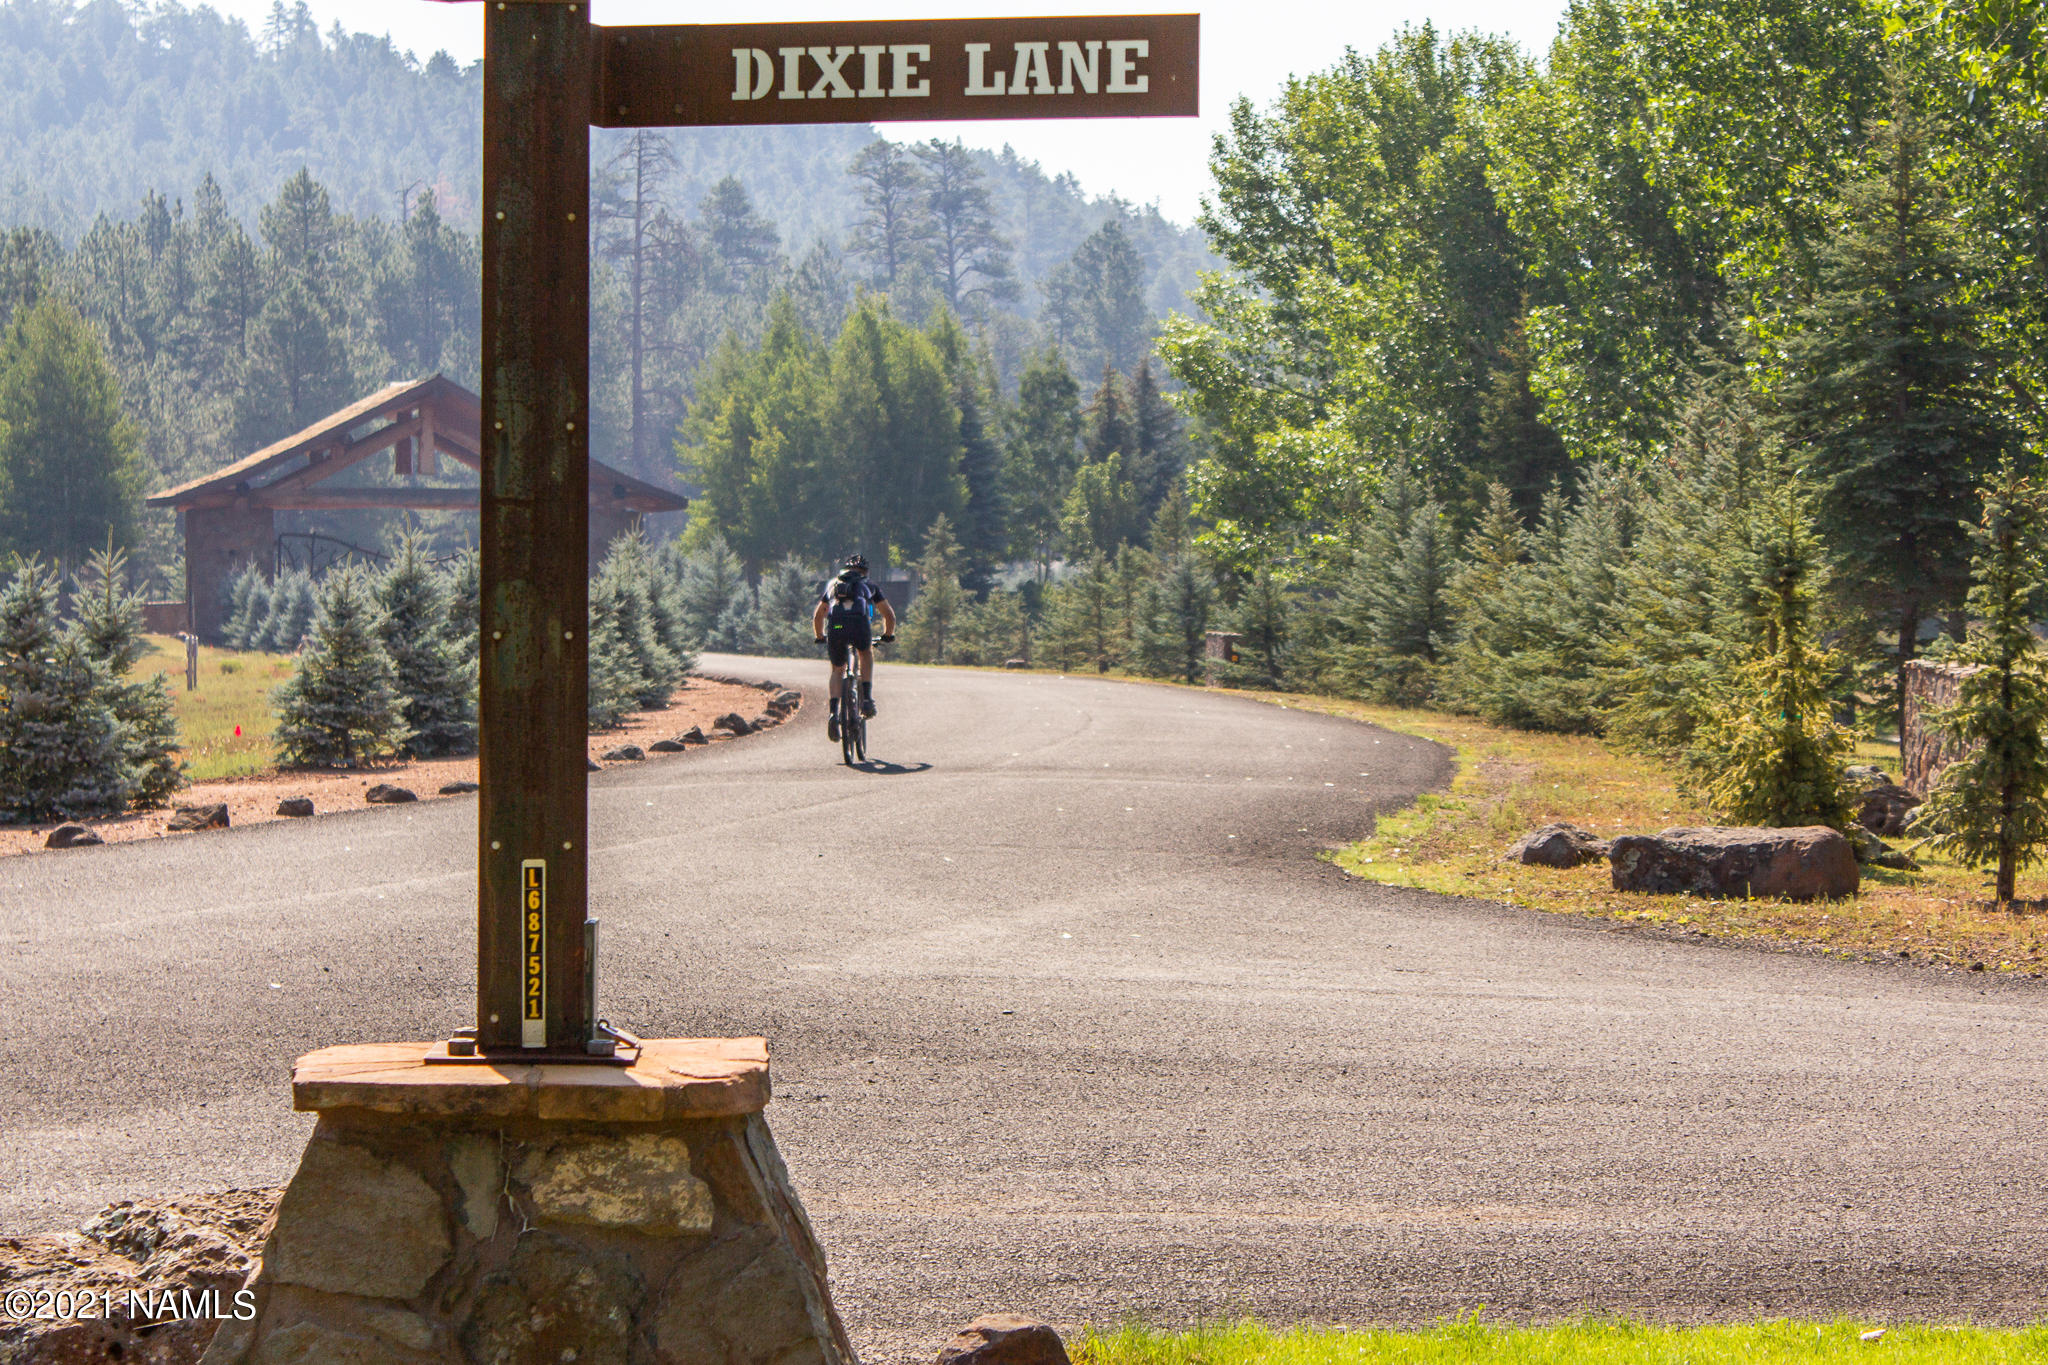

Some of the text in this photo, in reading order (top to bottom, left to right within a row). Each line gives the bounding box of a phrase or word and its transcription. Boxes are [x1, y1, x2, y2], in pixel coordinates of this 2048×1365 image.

[732, 40, 1149, 101] DIXIE LANE
[528, 868, 541, 1018] L687521
